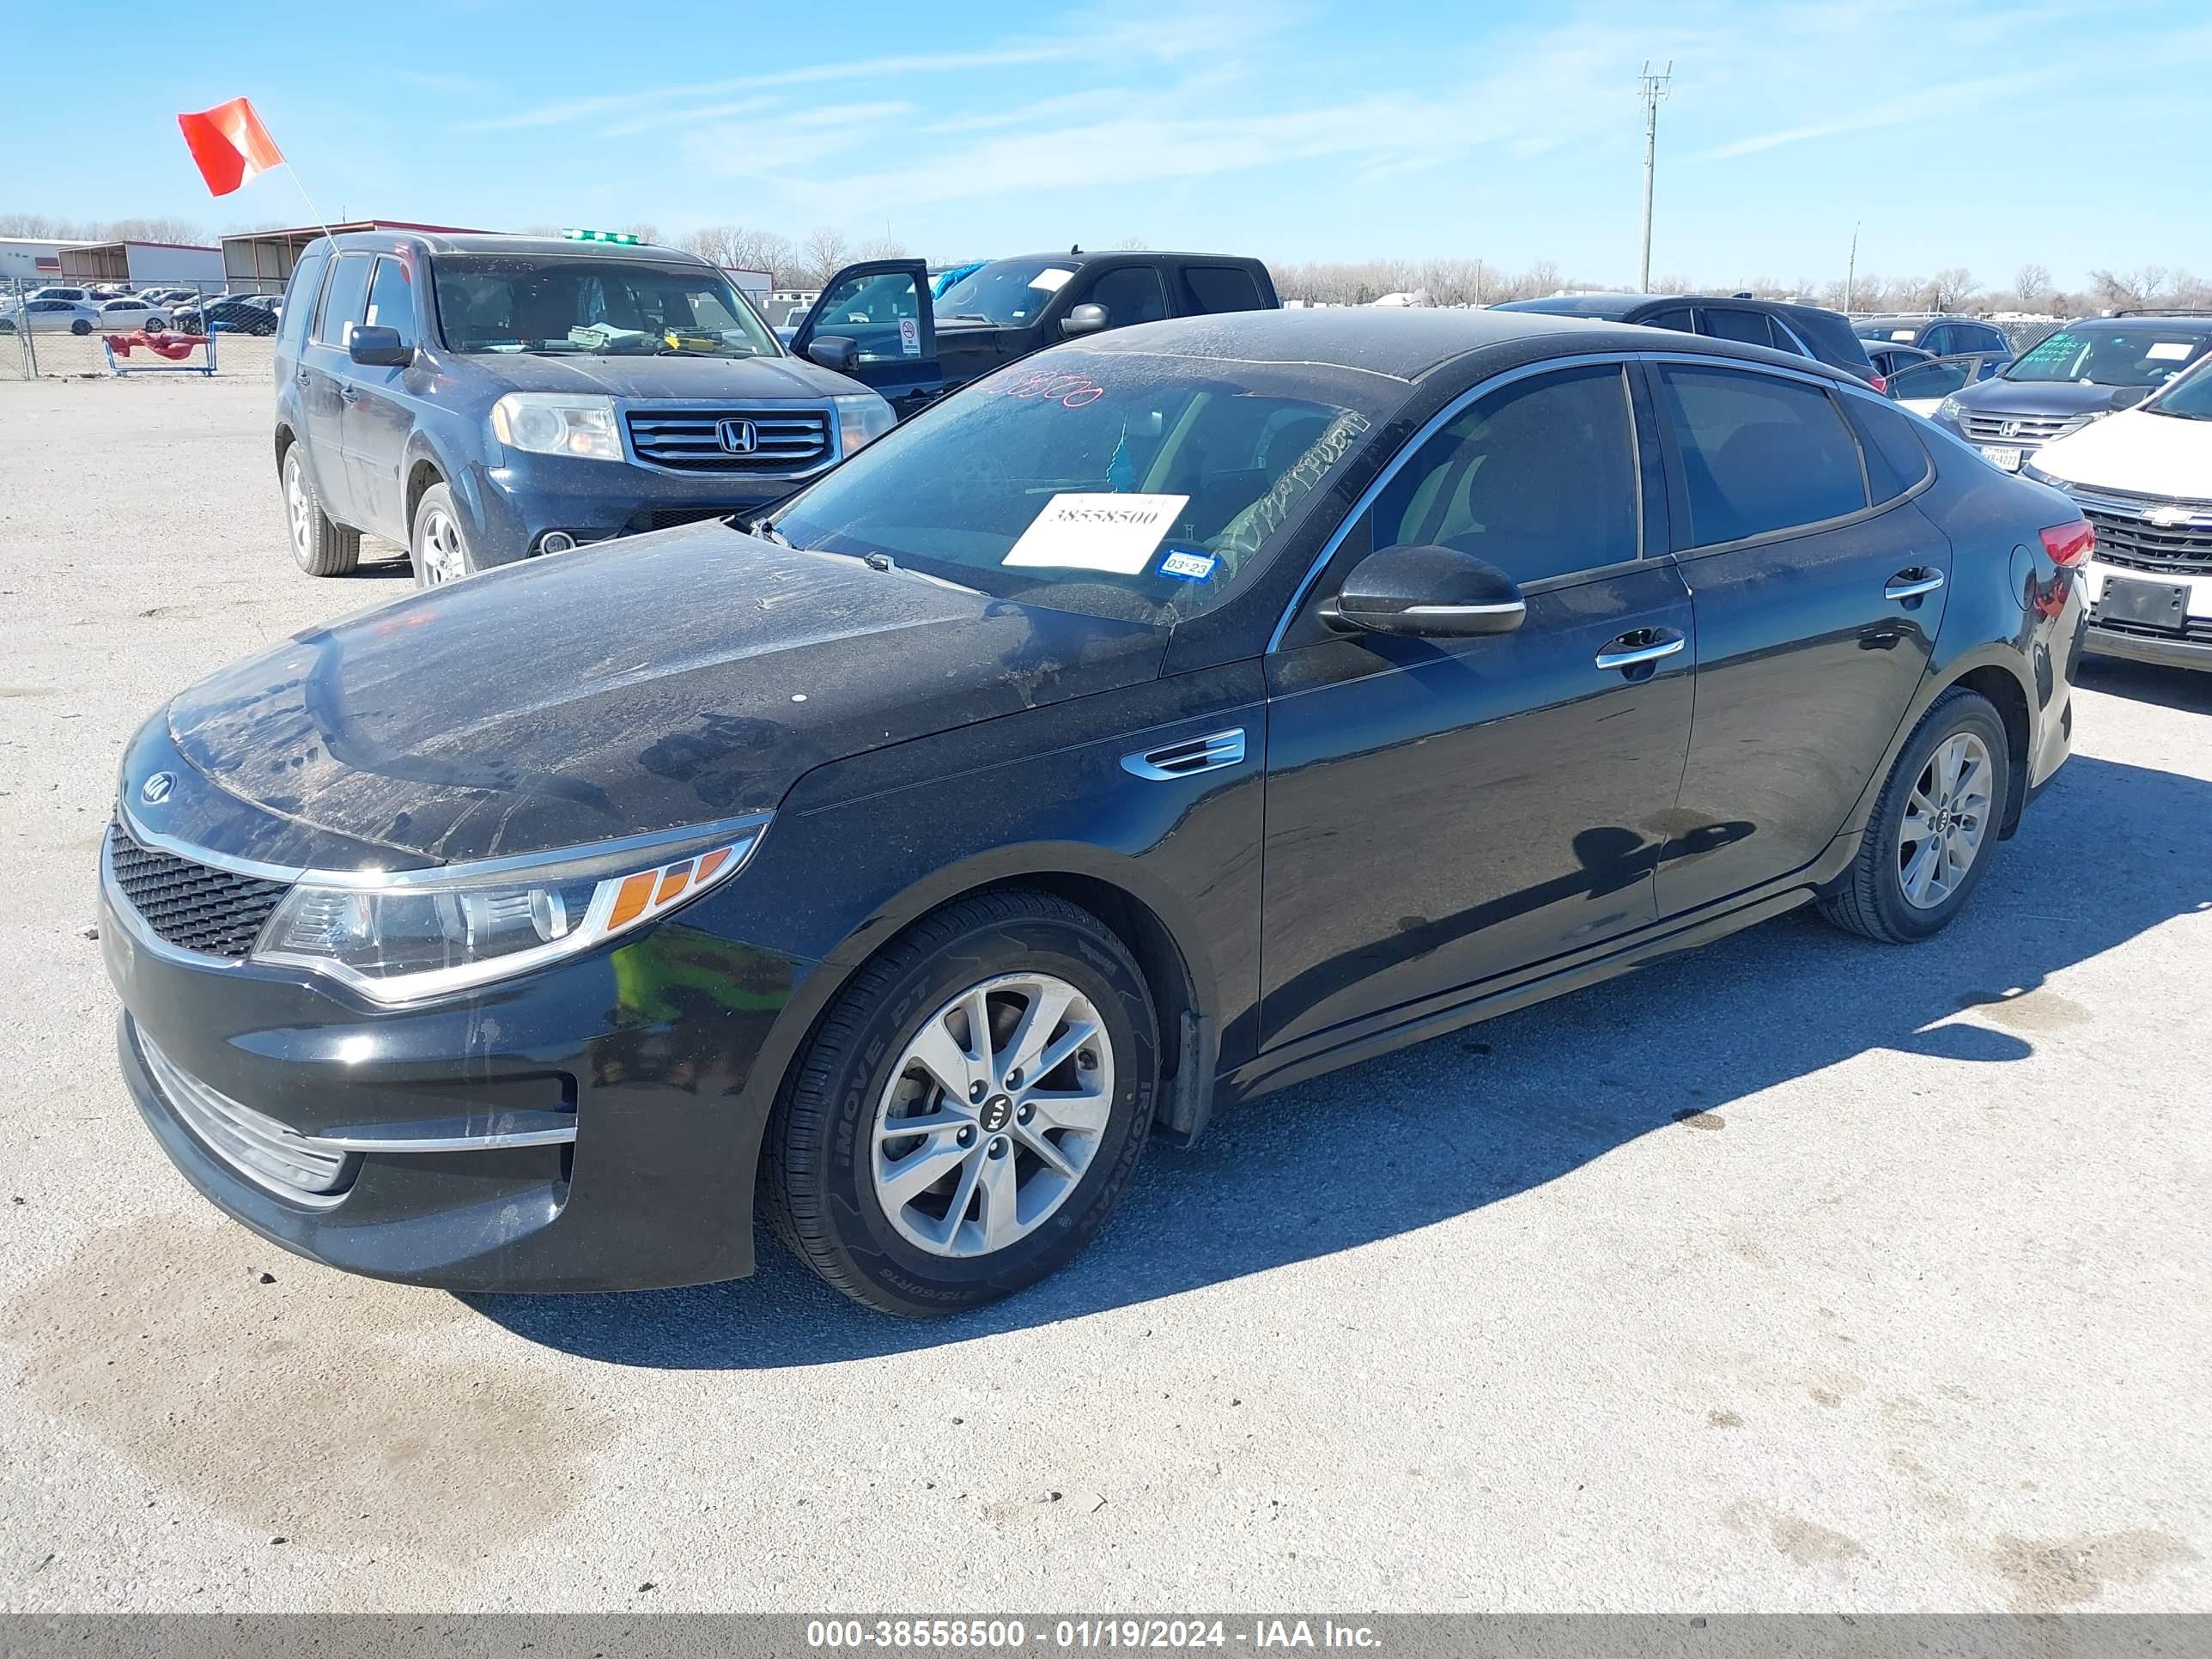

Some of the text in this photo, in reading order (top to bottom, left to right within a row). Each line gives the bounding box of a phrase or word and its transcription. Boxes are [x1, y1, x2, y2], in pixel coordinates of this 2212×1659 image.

[1048, 509, 1158, 525] 38558500
[890, 975, 931, 1028] PT
[988, 1098, 1006, 1129] KIA
